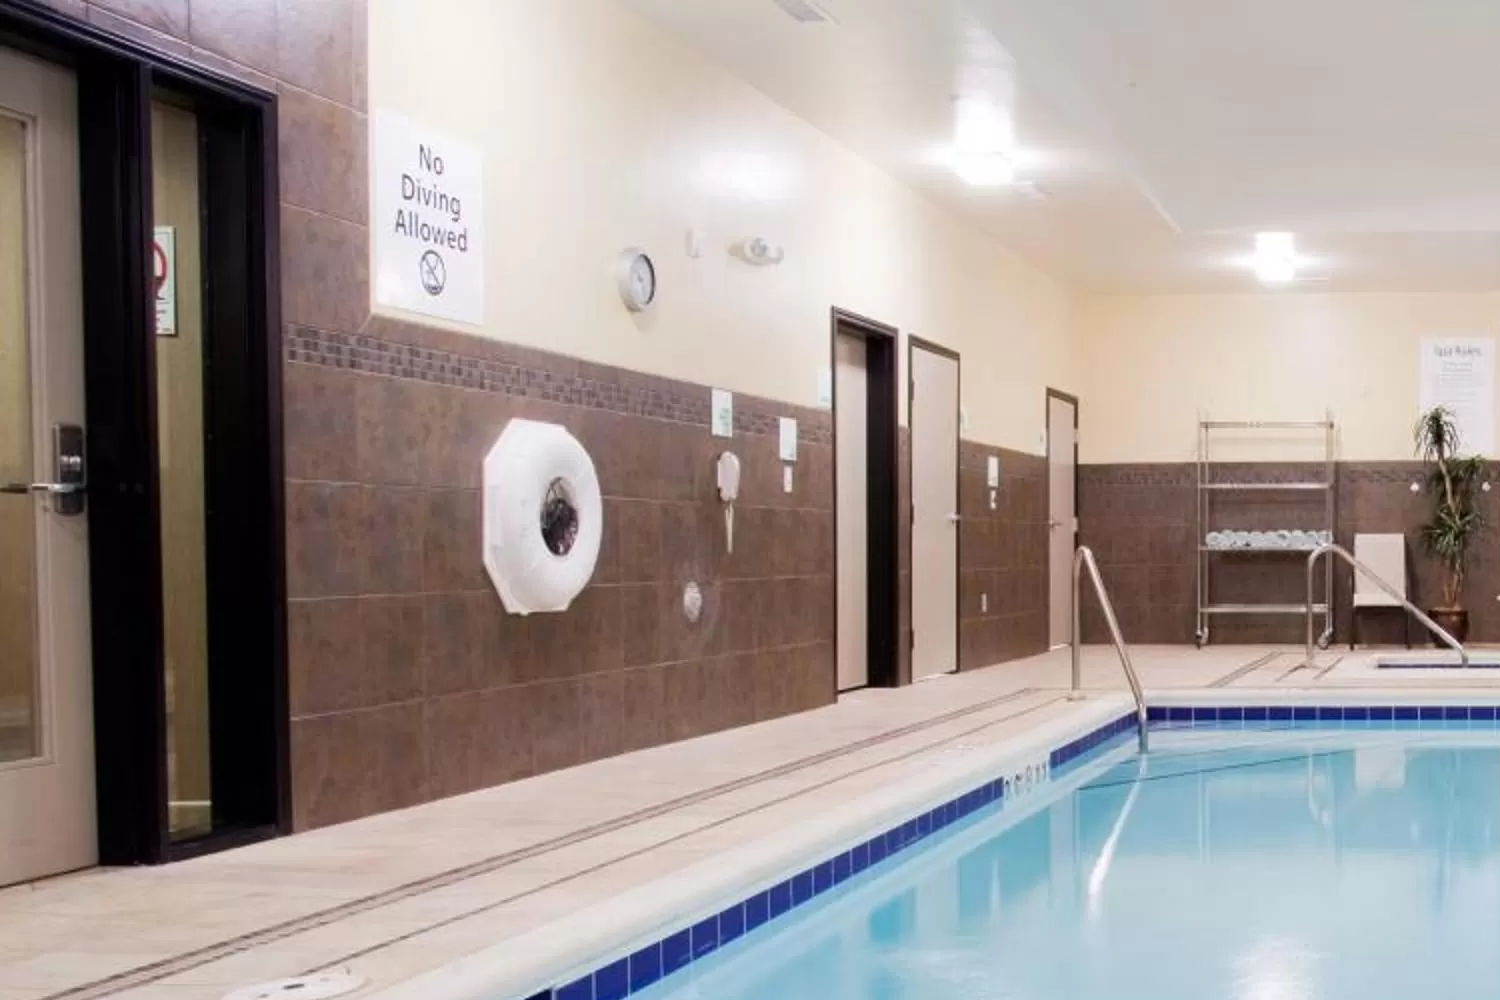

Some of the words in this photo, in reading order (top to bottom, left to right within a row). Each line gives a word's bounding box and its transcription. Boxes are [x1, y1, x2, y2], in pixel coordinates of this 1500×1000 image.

[418, 143, 445, 175] No
[401, 173, 461, 222] Diving
[394, 209, 468, 253] Allowed
